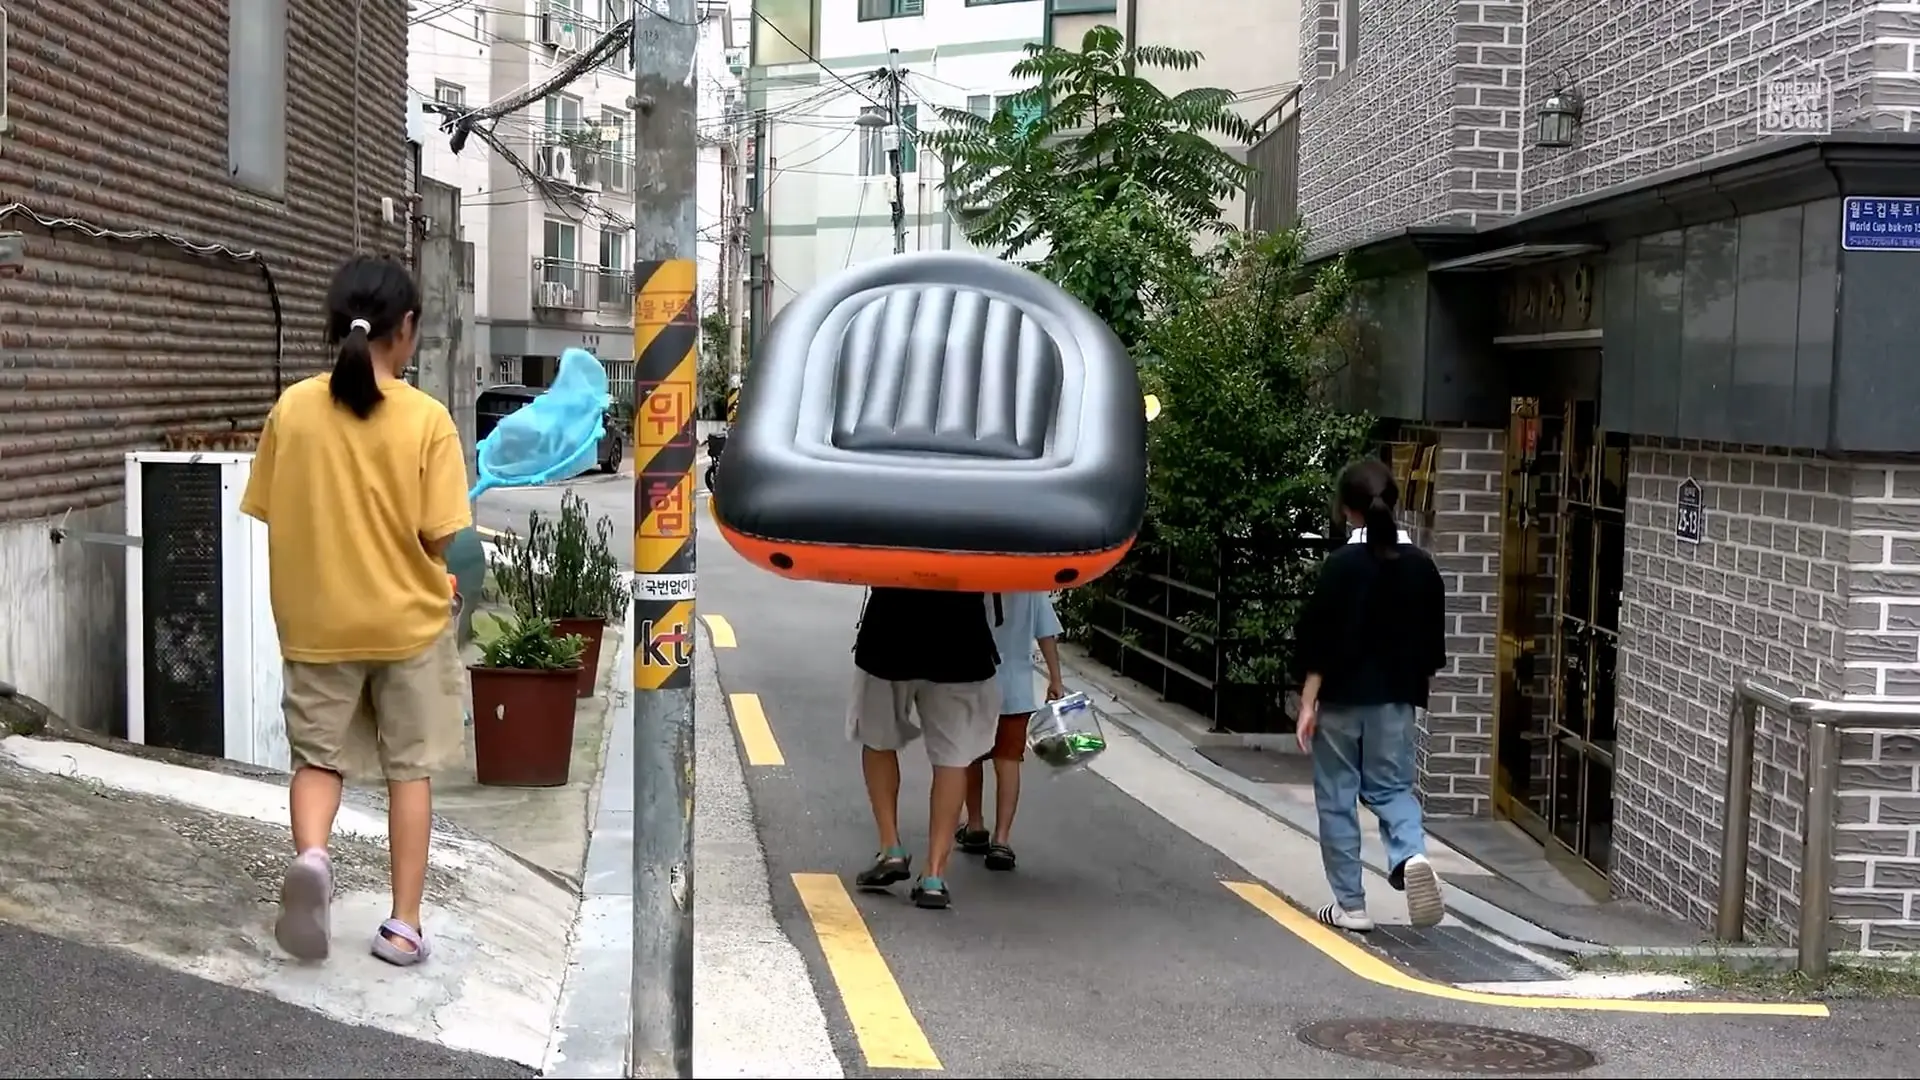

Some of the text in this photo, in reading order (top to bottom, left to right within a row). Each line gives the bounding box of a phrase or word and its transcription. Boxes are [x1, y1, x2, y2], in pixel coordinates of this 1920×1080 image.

[1849, 221, 1871, 232] World
[1873, 222, 1886, 234] Cup
[1888, 222, 1913, 233] buk-ro
[1678, 508, 1698, 534] 25-13
[645, 579, 690, 596] 국번없이
[642, 620, 690, 667] kt
